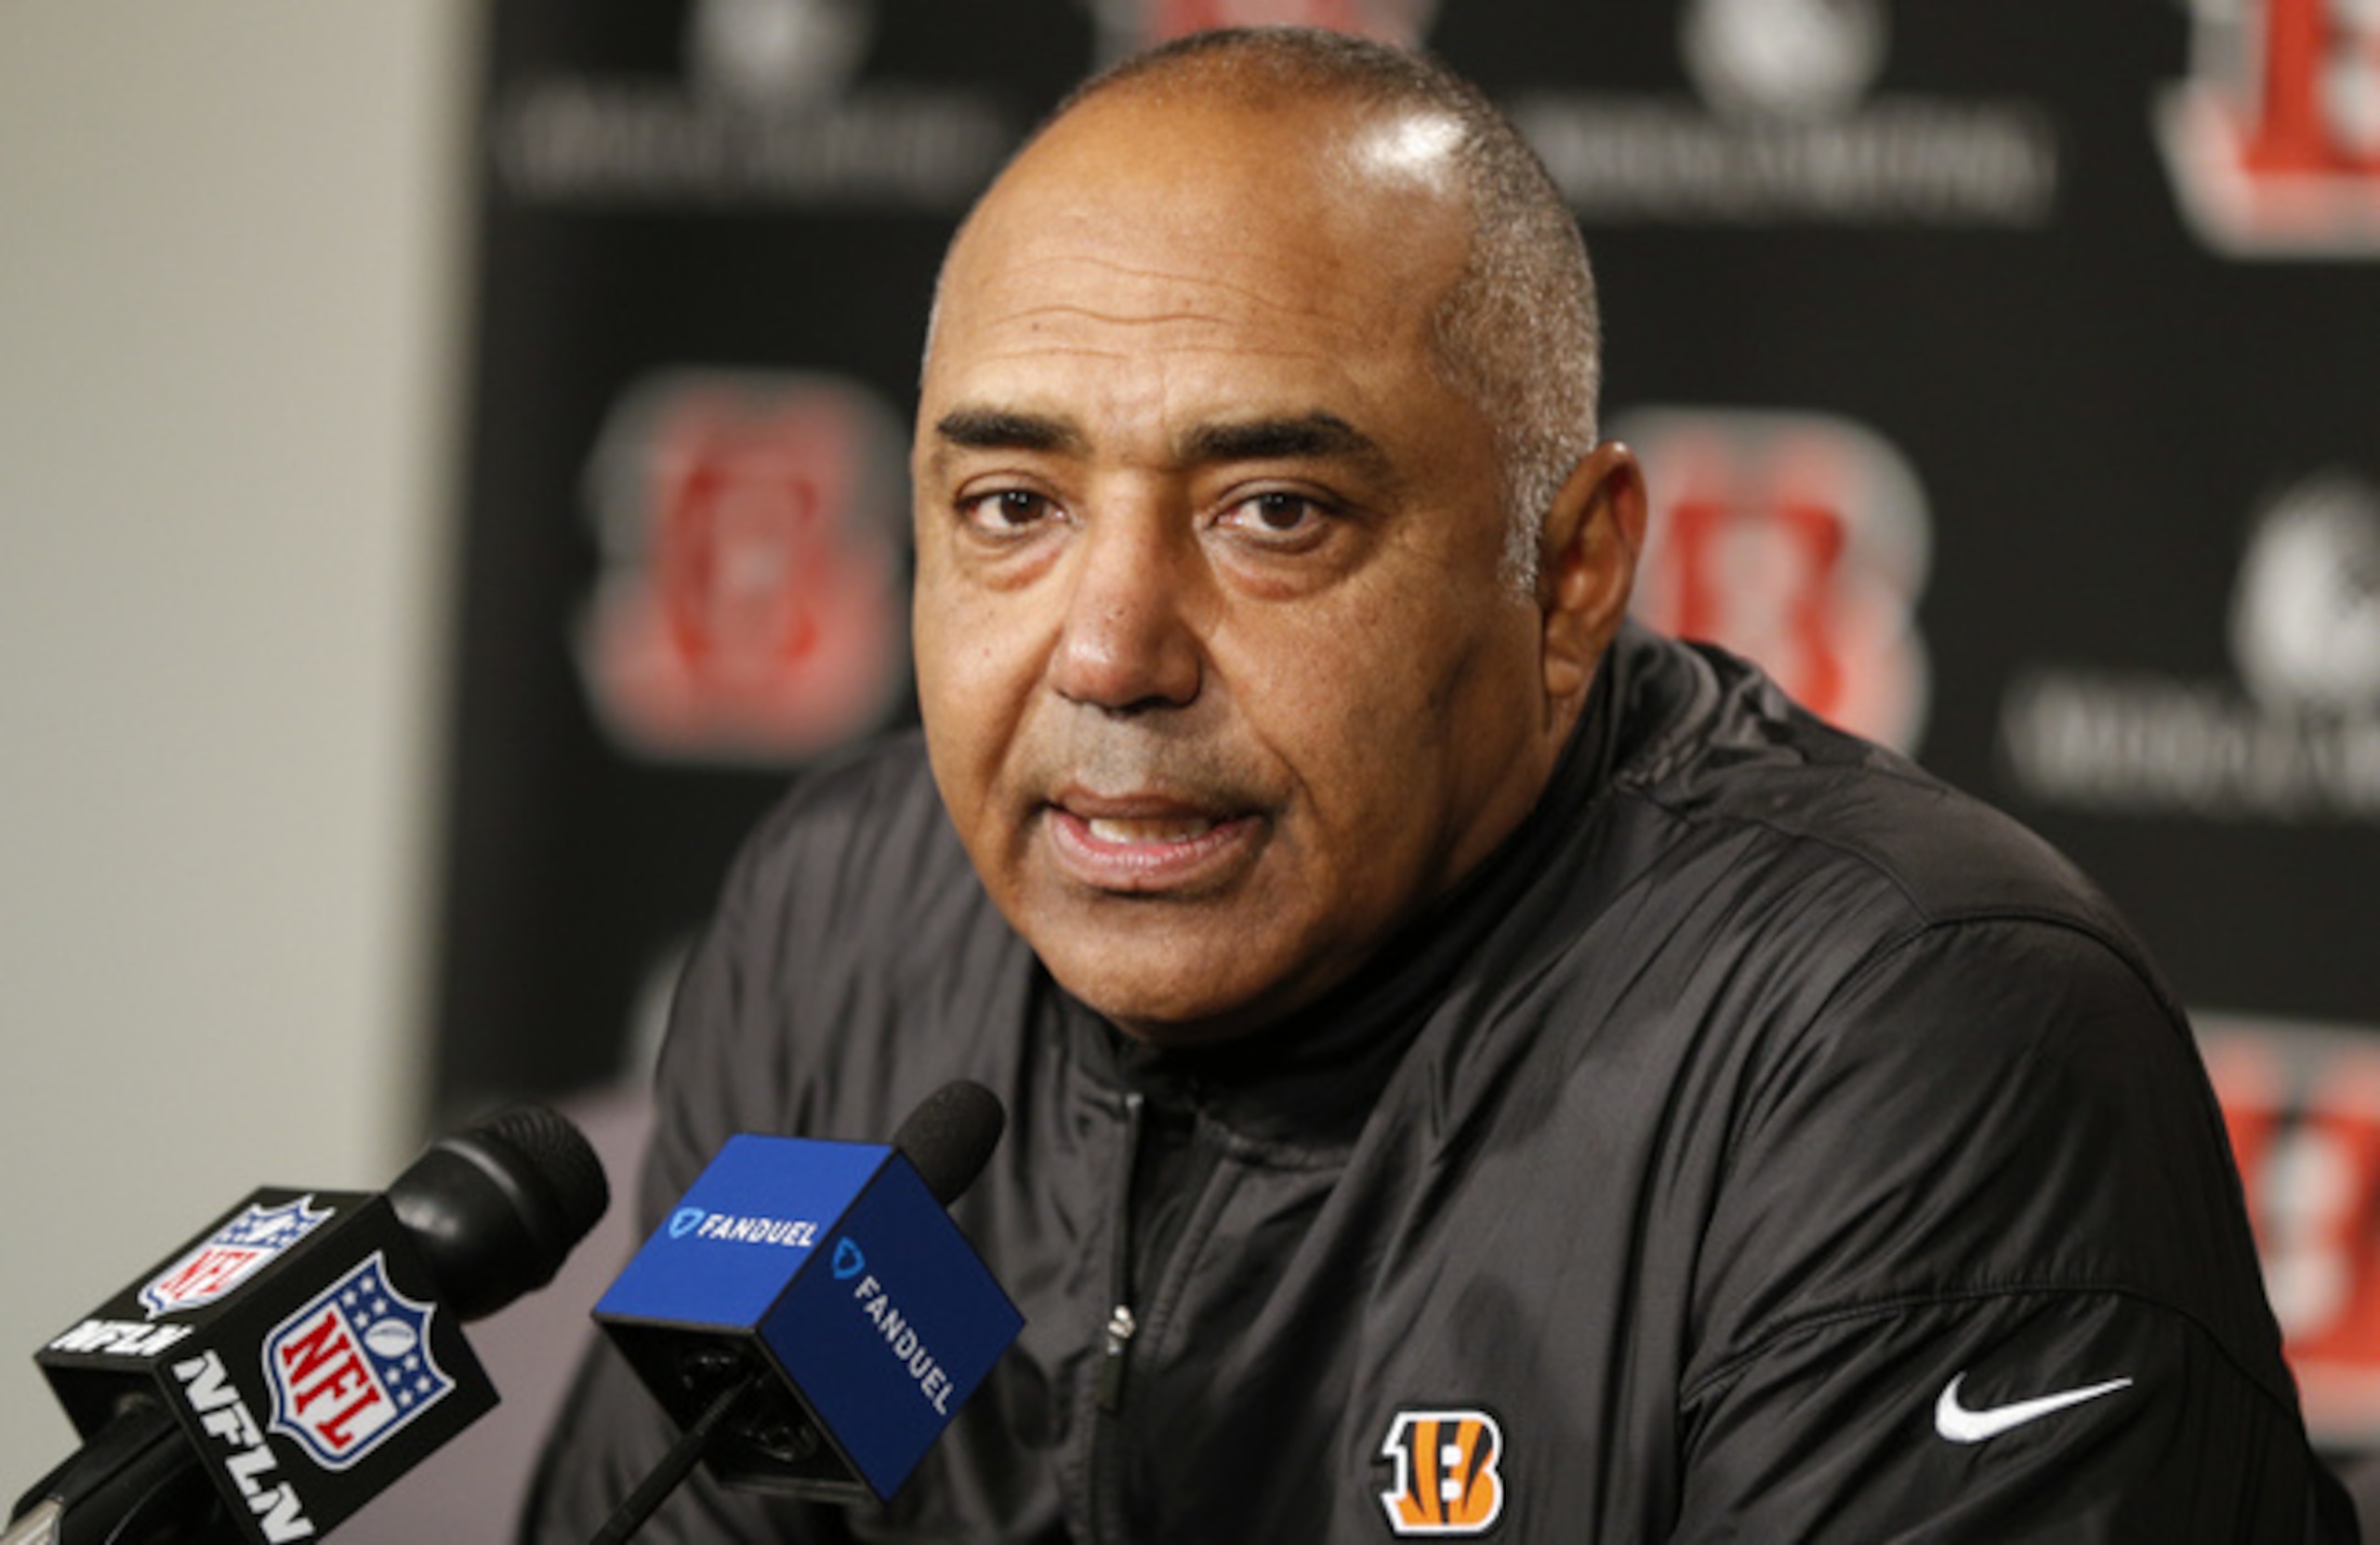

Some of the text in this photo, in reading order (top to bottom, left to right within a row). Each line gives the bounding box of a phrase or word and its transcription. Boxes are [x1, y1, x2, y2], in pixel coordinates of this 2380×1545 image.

[160, 1248, 258, 1300] NFL
[696, 1213, 818, 1247] FANDUEL
[49, 1319, 194, 1355] NFLN
[281, 1311, 381, 1449] NFL
[854, 1275, 956, 1415] FANDUEL
[173, 1350, 313, 1544] NFLN
